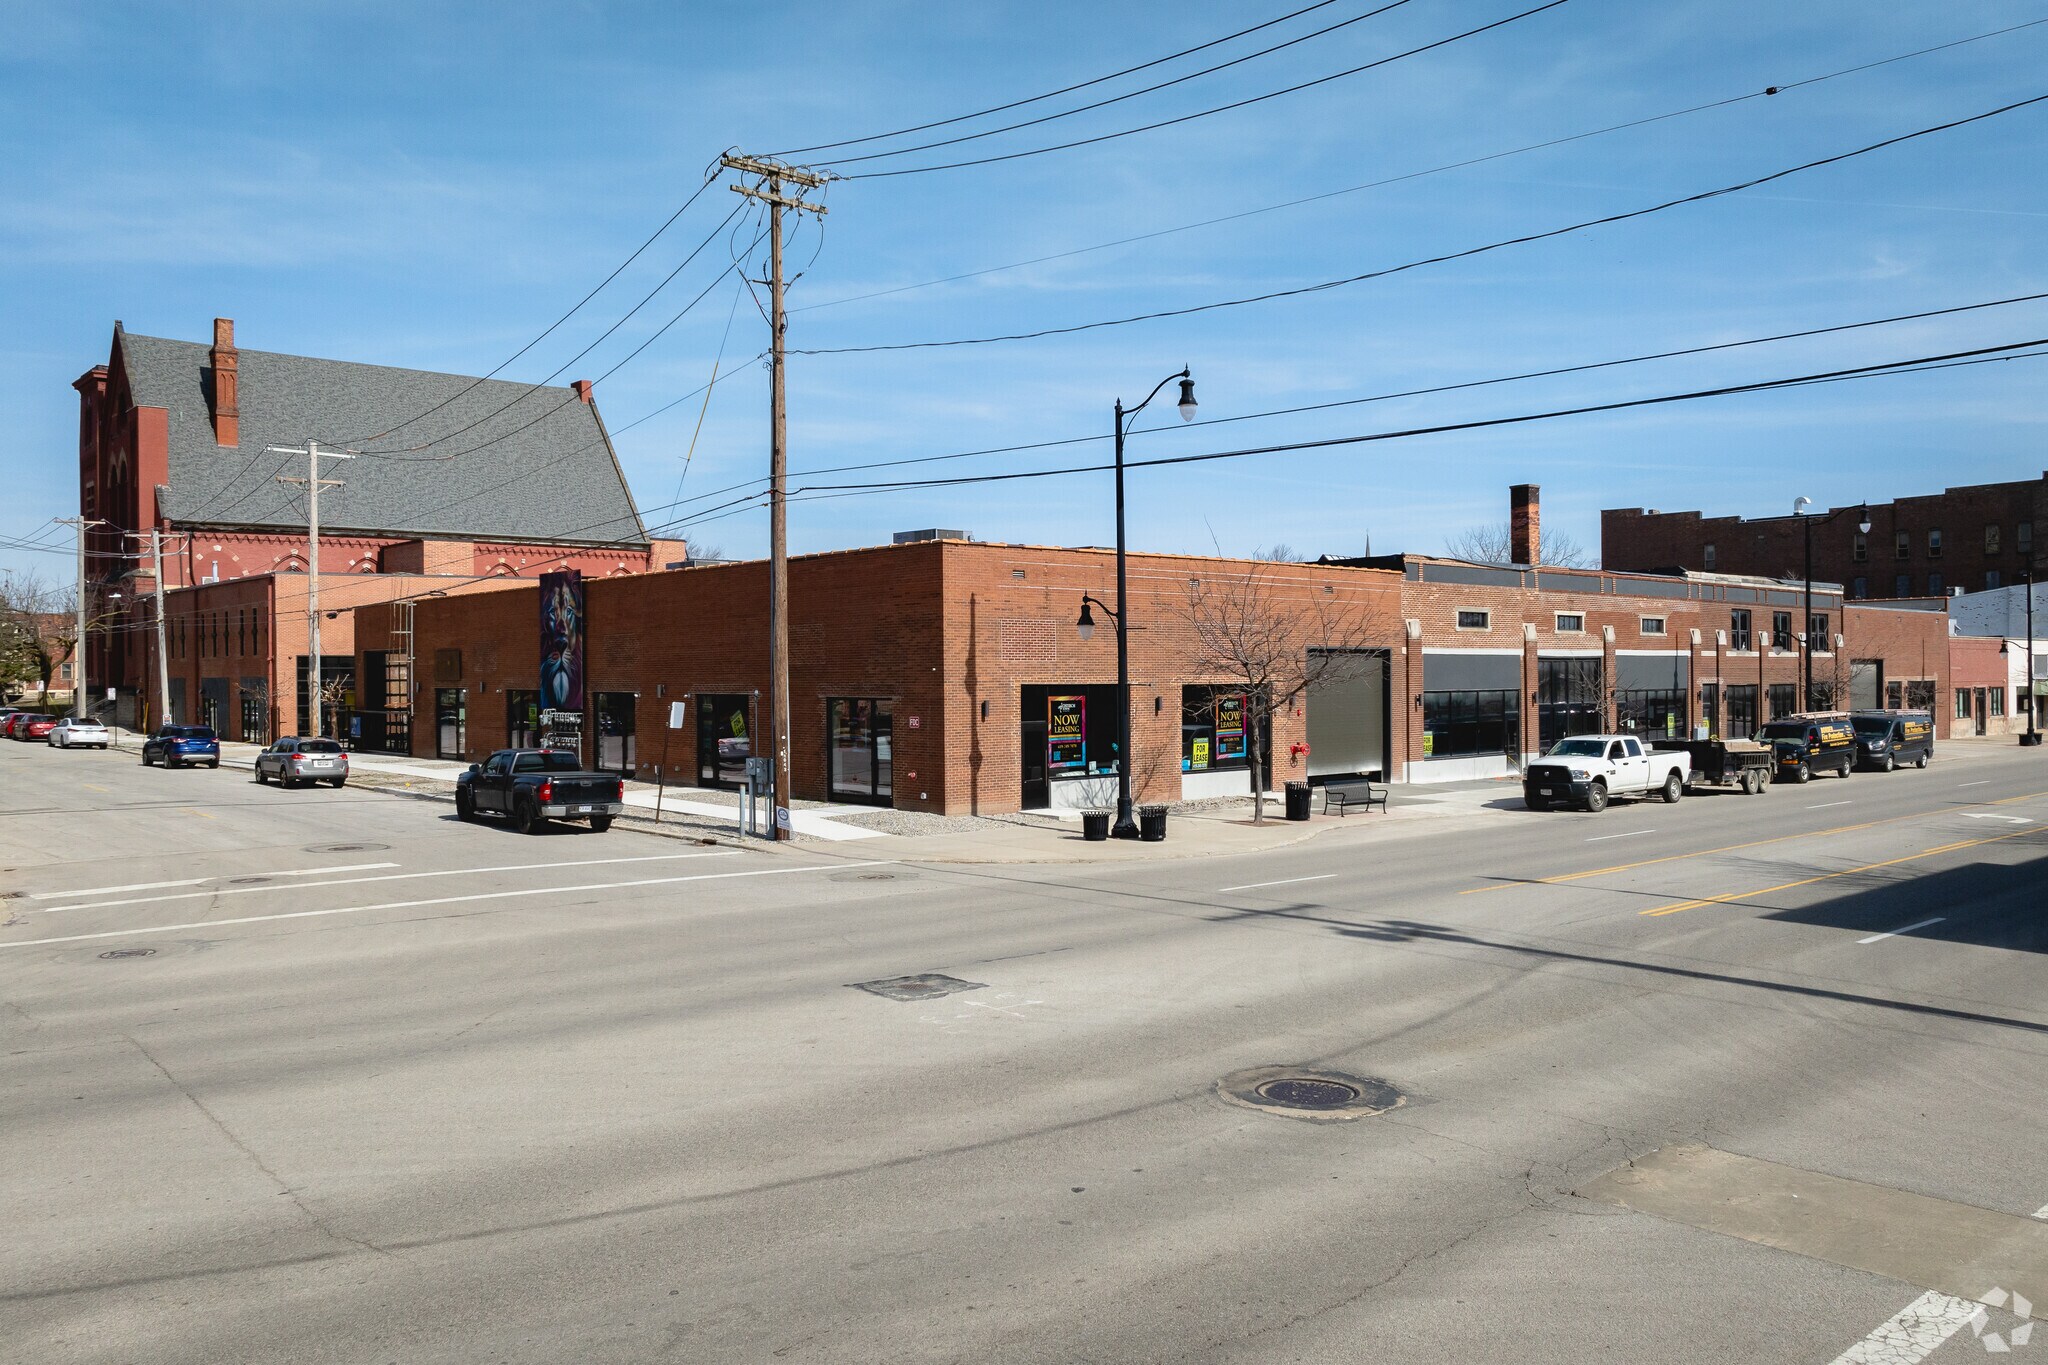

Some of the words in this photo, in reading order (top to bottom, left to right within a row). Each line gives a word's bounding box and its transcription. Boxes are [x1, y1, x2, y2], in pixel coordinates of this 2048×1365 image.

[1054, 715, 1080, 726] NOW
[1220, 711, 1241, 721] NOW
[1054, 725, 1080, 733] LEASING
[1220, 721, 1242, 729] LEASING
[1196, 744, 1206, 753] FOR
[1193, 753, 1208, 762] LEASE
